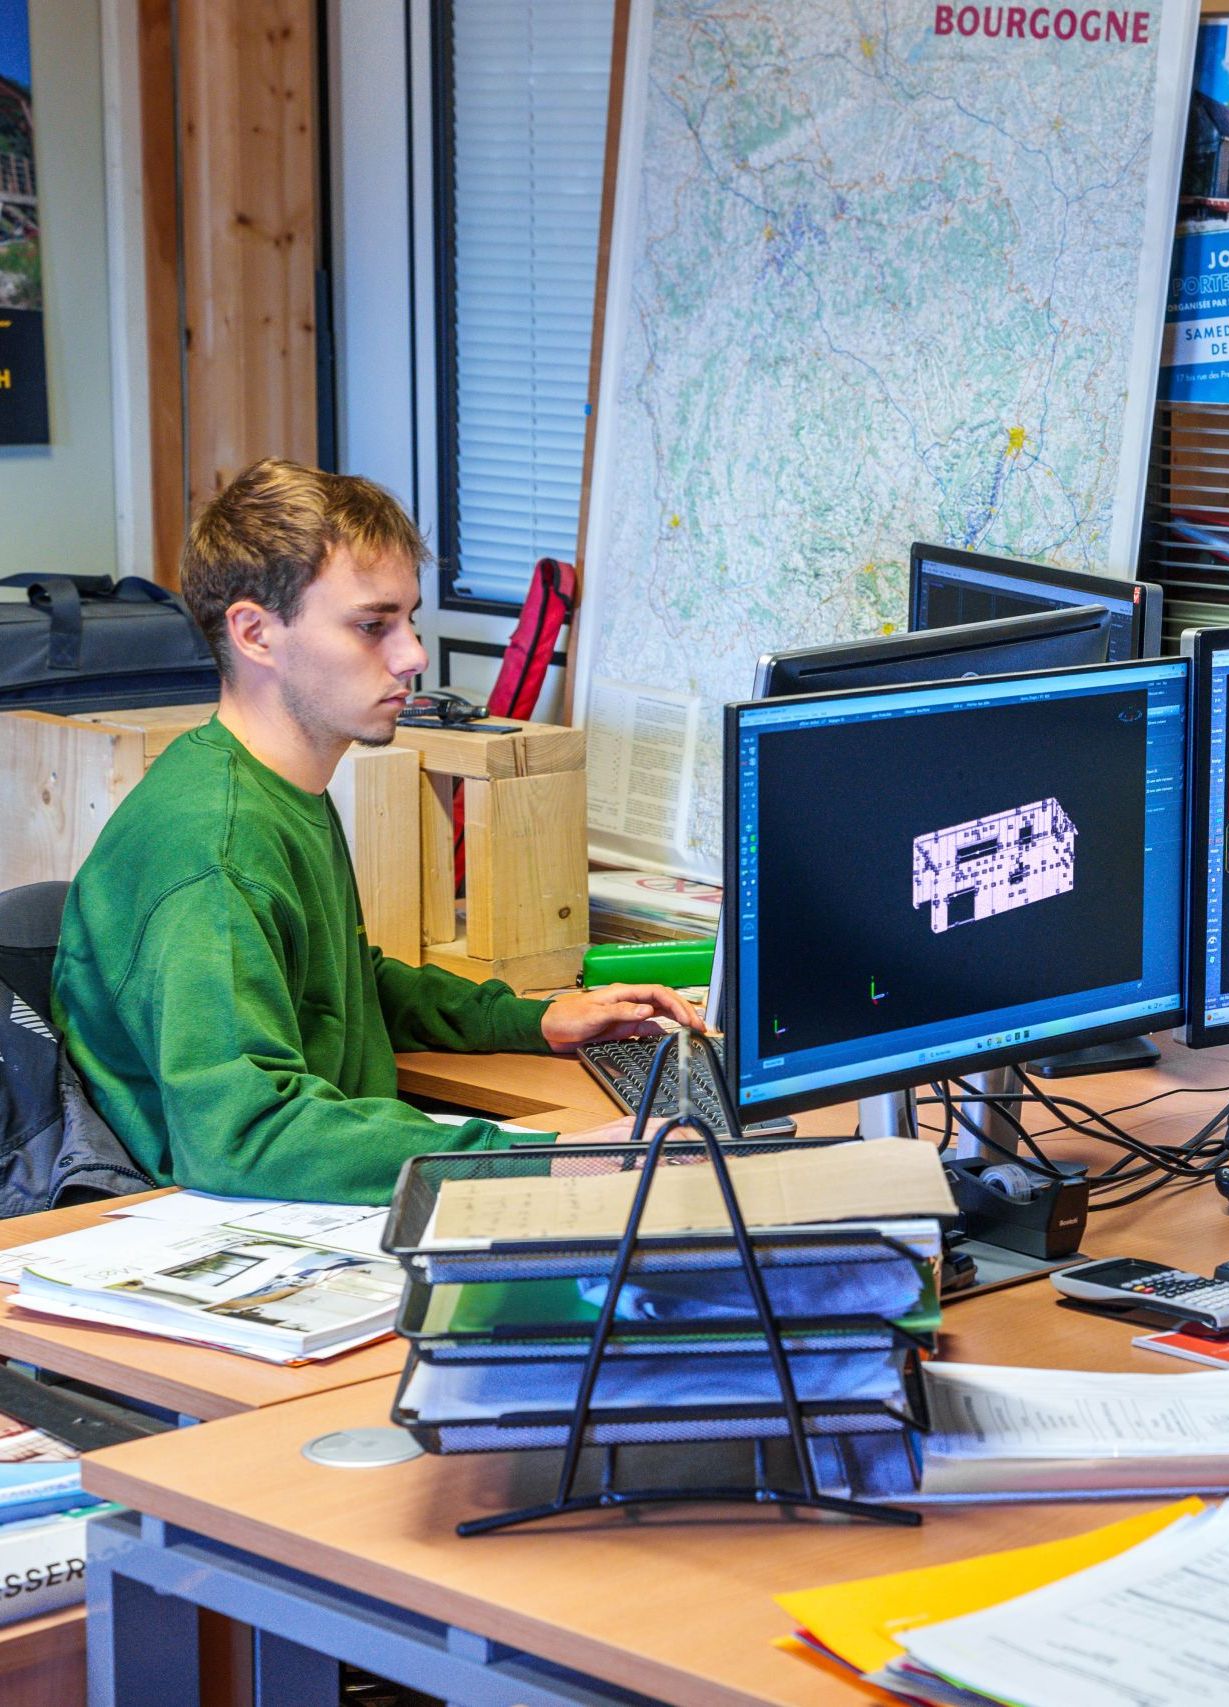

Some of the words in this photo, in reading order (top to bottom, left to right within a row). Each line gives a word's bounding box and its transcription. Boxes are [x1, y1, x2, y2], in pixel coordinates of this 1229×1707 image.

[934, 5, 1150, 43] BOURGOGNE
[1168, 300, 1210, 312] ORGANISÉE
[1212, 300, 1228, 308] PAR
[1212, 343, 1227, 355] DE
[0, 1558, 85, 1598] SSER
